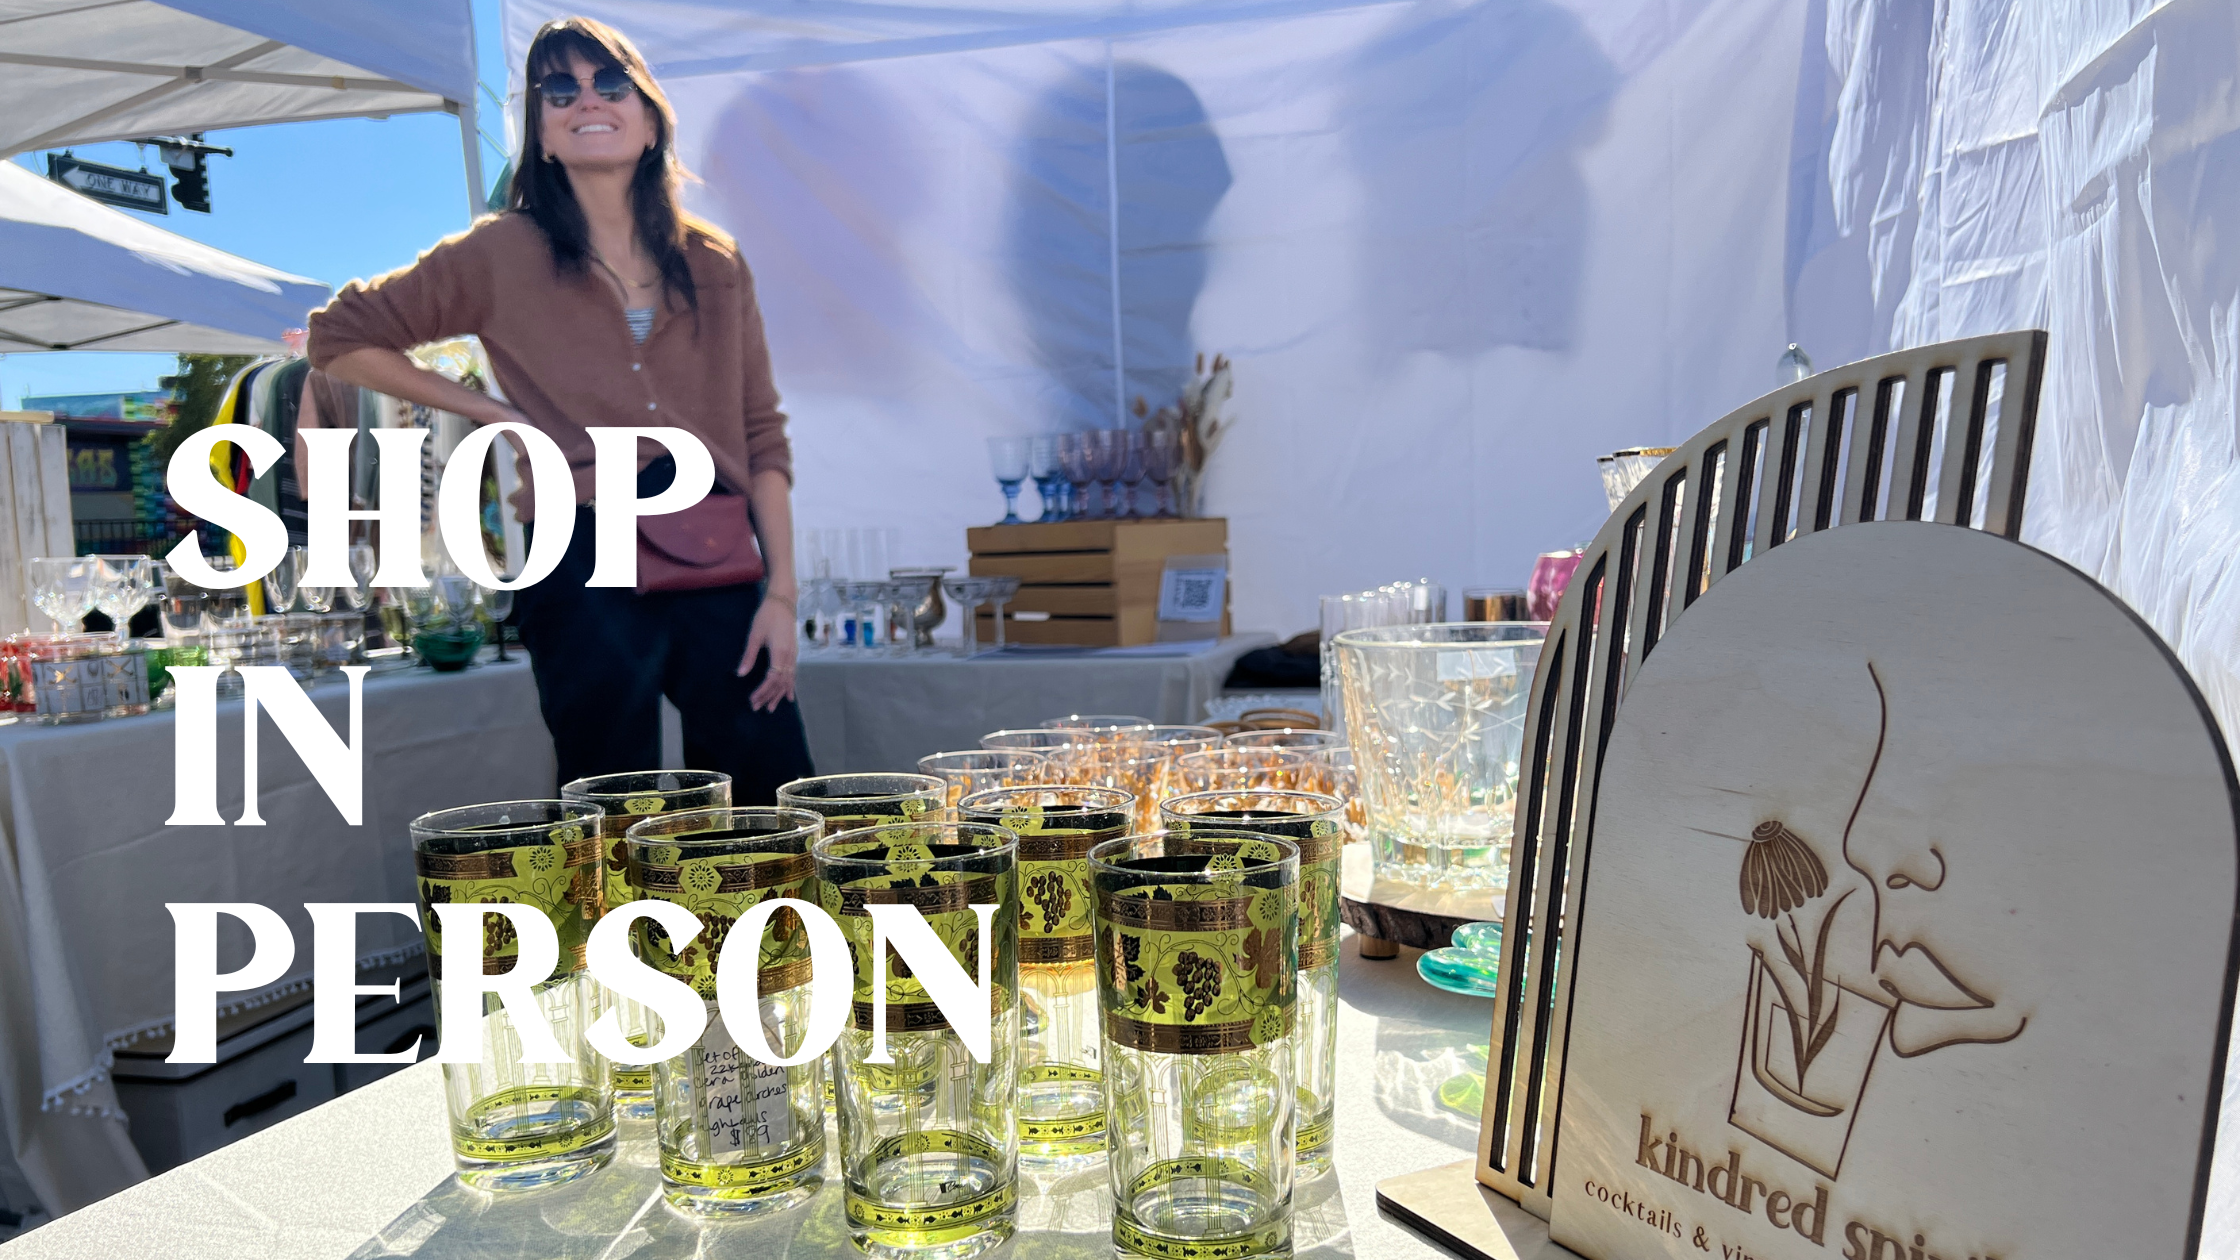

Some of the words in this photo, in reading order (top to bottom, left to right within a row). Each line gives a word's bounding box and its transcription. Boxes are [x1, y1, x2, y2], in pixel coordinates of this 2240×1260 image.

[87, 173, 115, 191] ONE
[120, 180, 151, 198] WAY
[1584, 1180, 1682, 1238] cocktails
[1692, 1226, 1710, 1252] &
[1635, 1113, 1829, 1247] kindred
